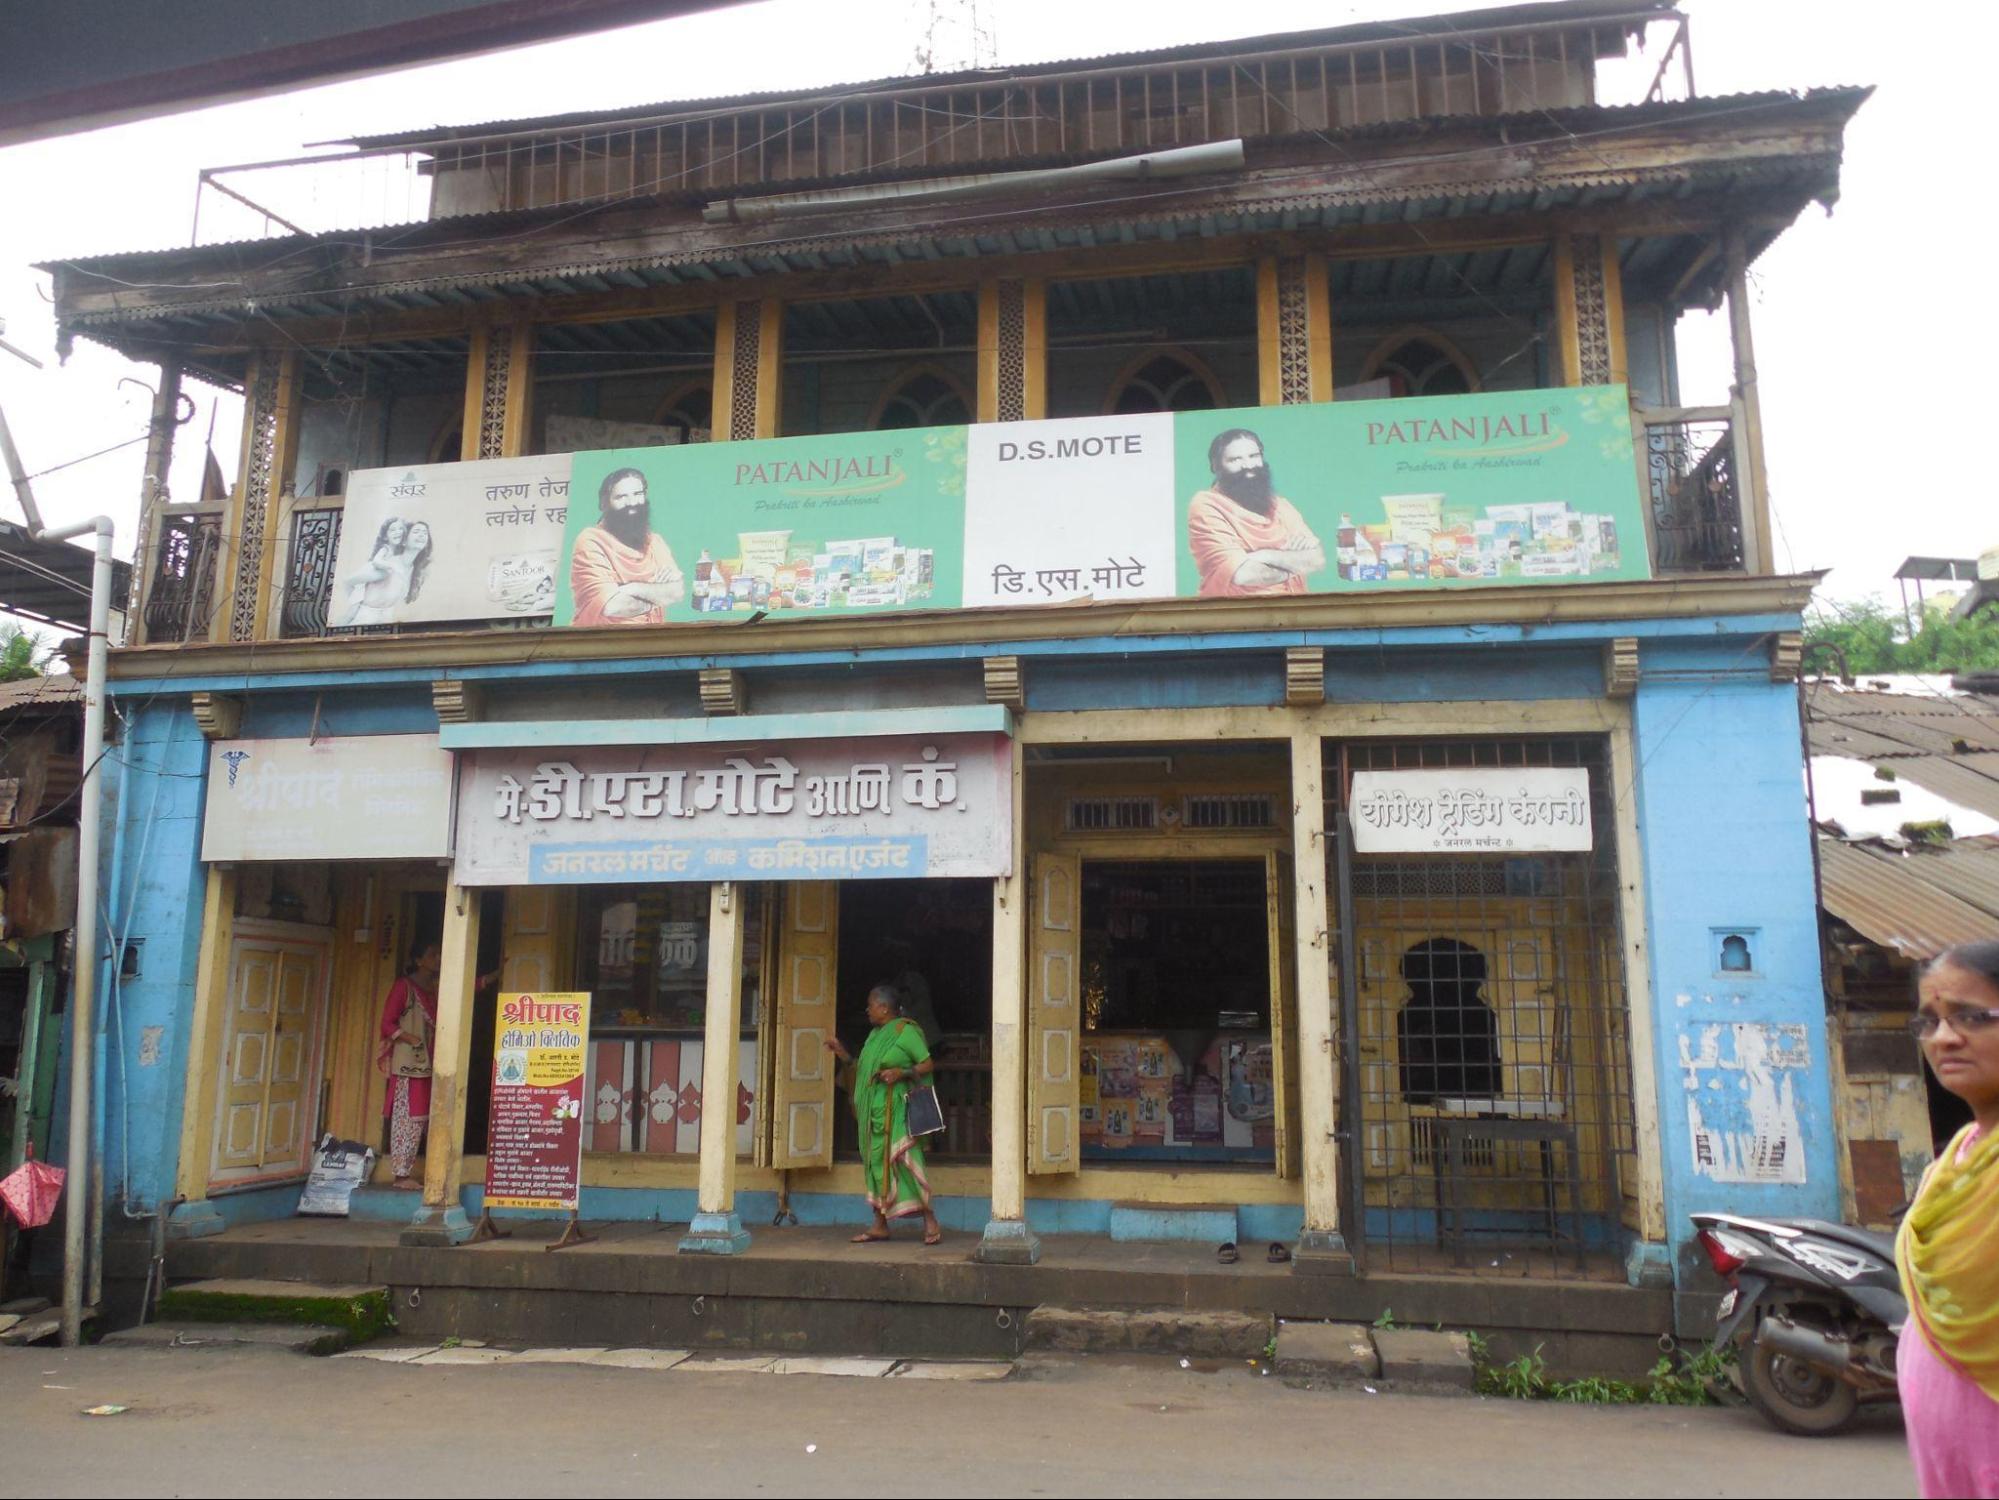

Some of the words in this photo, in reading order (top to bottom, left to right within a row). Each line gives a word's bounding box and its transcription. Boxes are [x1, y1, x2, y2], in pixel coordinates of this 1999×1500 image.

[1366, 412, 1550, 445] PATANJALI
[998, 434, 1143, 462] D.S.MOTE
[734, 454, 893, 486] PATANJALI
[485, 483, 531, 501] तरुण
[485, 504, 537, 527] त्वचेचं
[805, 763, 891, 817] आणि
[1360, 789, 1433, 829] योगेश
[1437, 788, 1503, 836] ट्रेडिंग
[1508, 788, 1585, 828] कंपनी
[542, 850, 626, 874] जनरल
[502, 995, 582, 1027] श्रीपाद
